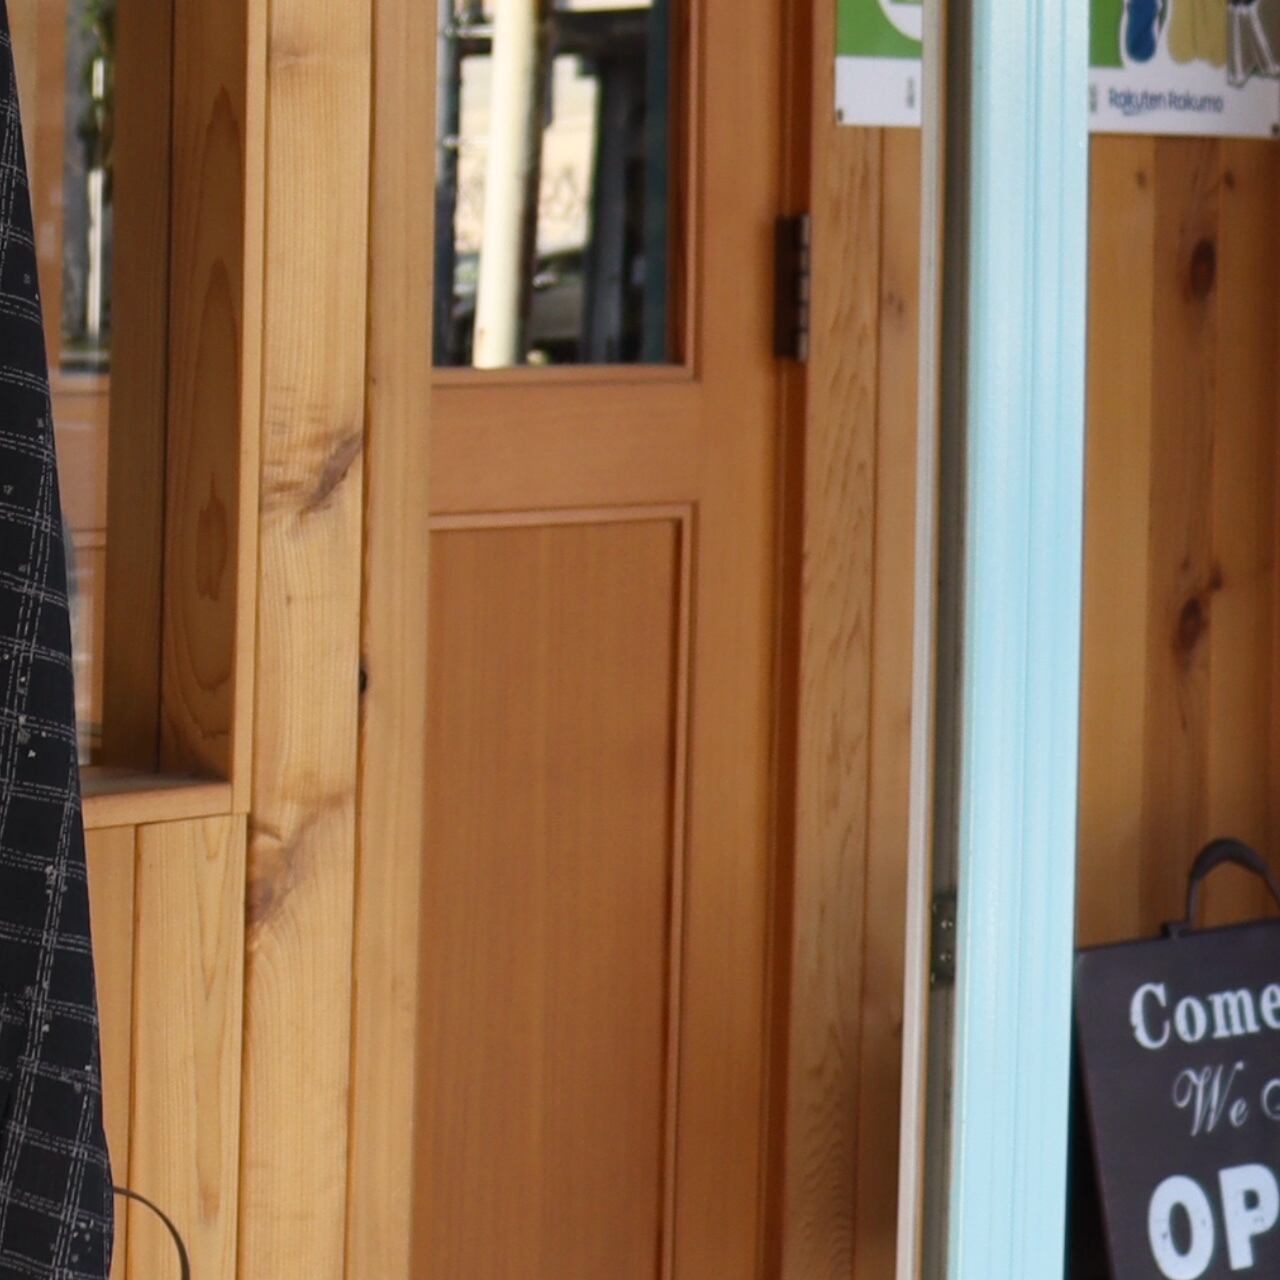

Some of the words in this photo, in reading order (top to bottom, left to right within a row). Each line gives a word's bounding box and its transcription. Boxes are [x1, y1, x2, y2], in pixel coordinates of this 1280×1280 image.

[1109, 87, 1166, 114] Rakuten
[1130, 981, 1280, 1050] Come
[1172, 1061, 1250, 1137] We
